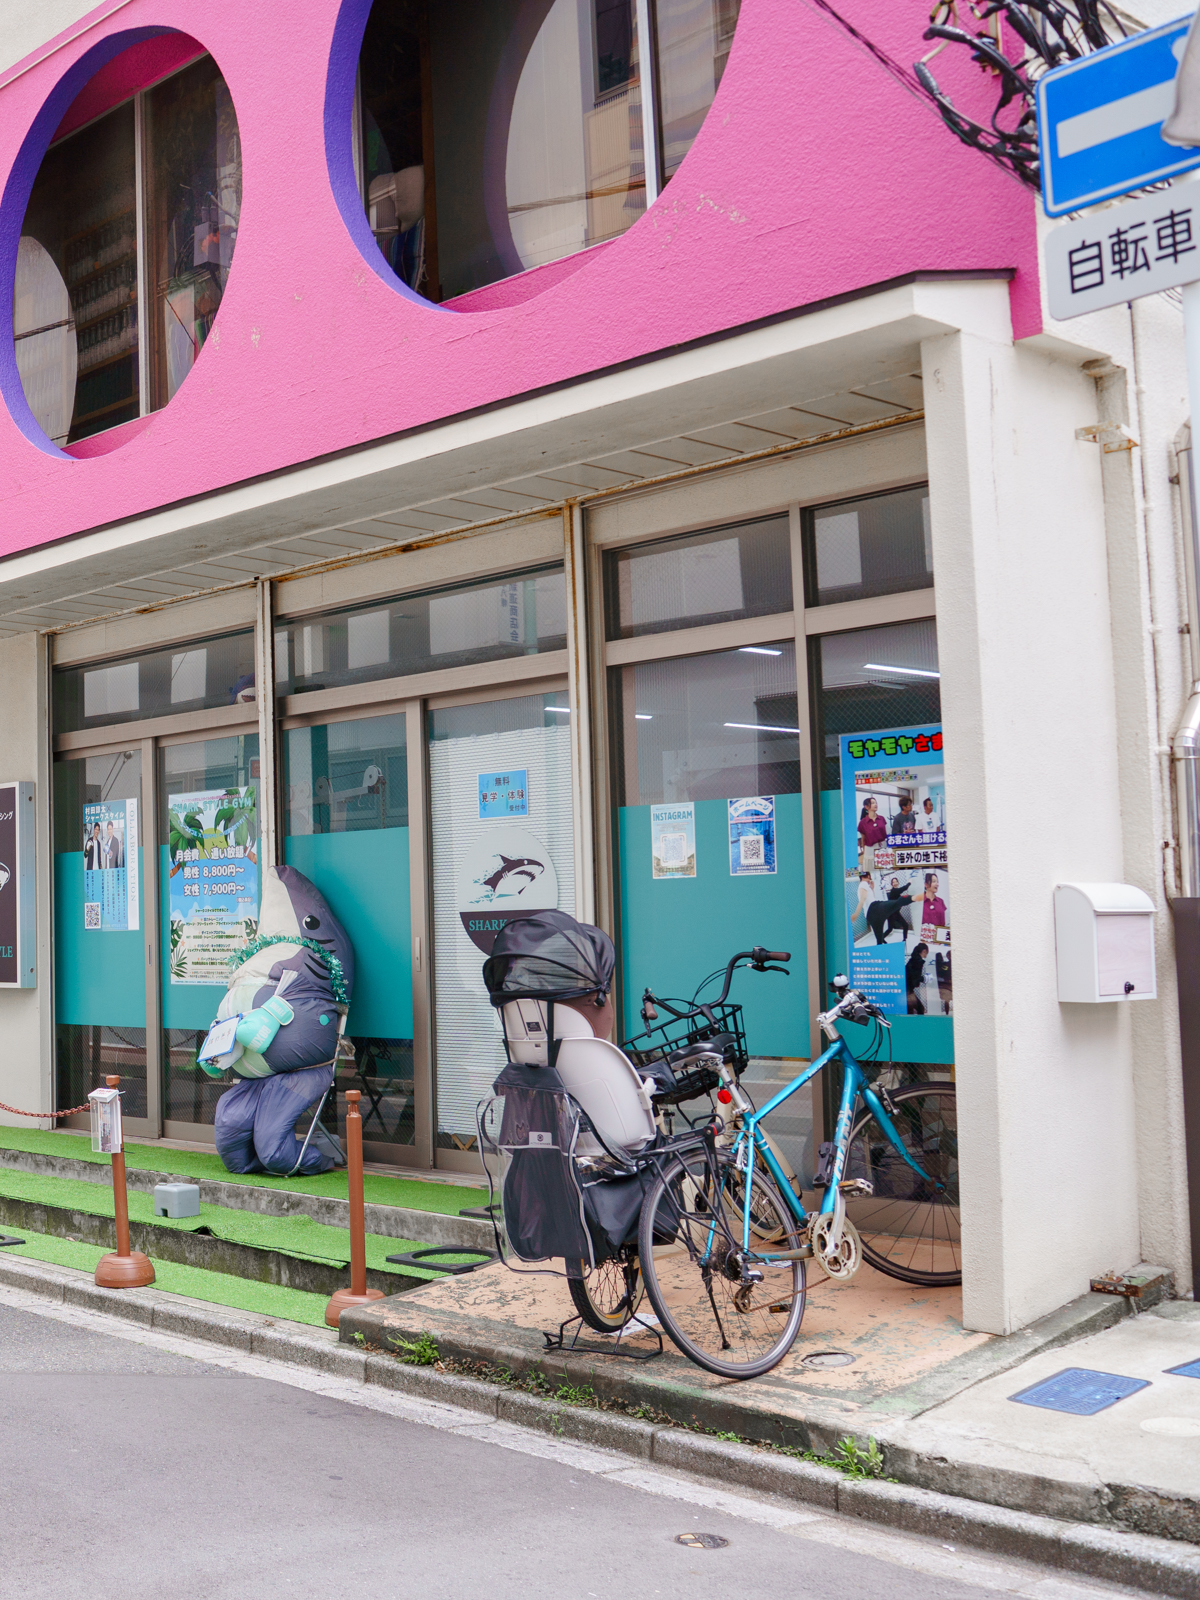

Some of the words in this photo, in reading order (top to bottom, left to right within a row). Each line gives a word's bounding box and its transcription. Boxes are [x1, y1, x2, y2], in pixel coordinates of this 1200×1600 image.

[1068, 207, 1197, 295] 自転車
[495, 776, 510, 787] 無料
[481, 789, 525, 804] 見学・体験
[172, 802, 200, 814] SHARK
[202, 798, 229, 812] STYLE
[232, 796, 252, 809] GYM
[509, 804, 526, 813] 受付中
[733, 799, 771, 814] ホームページ
[653, 810, 693, 822] INSTAGRAM
[175, 847, 200, 862] 月会費
[183, 865, 200, 880] 男性
[183, 883, 200, 897] 女性
